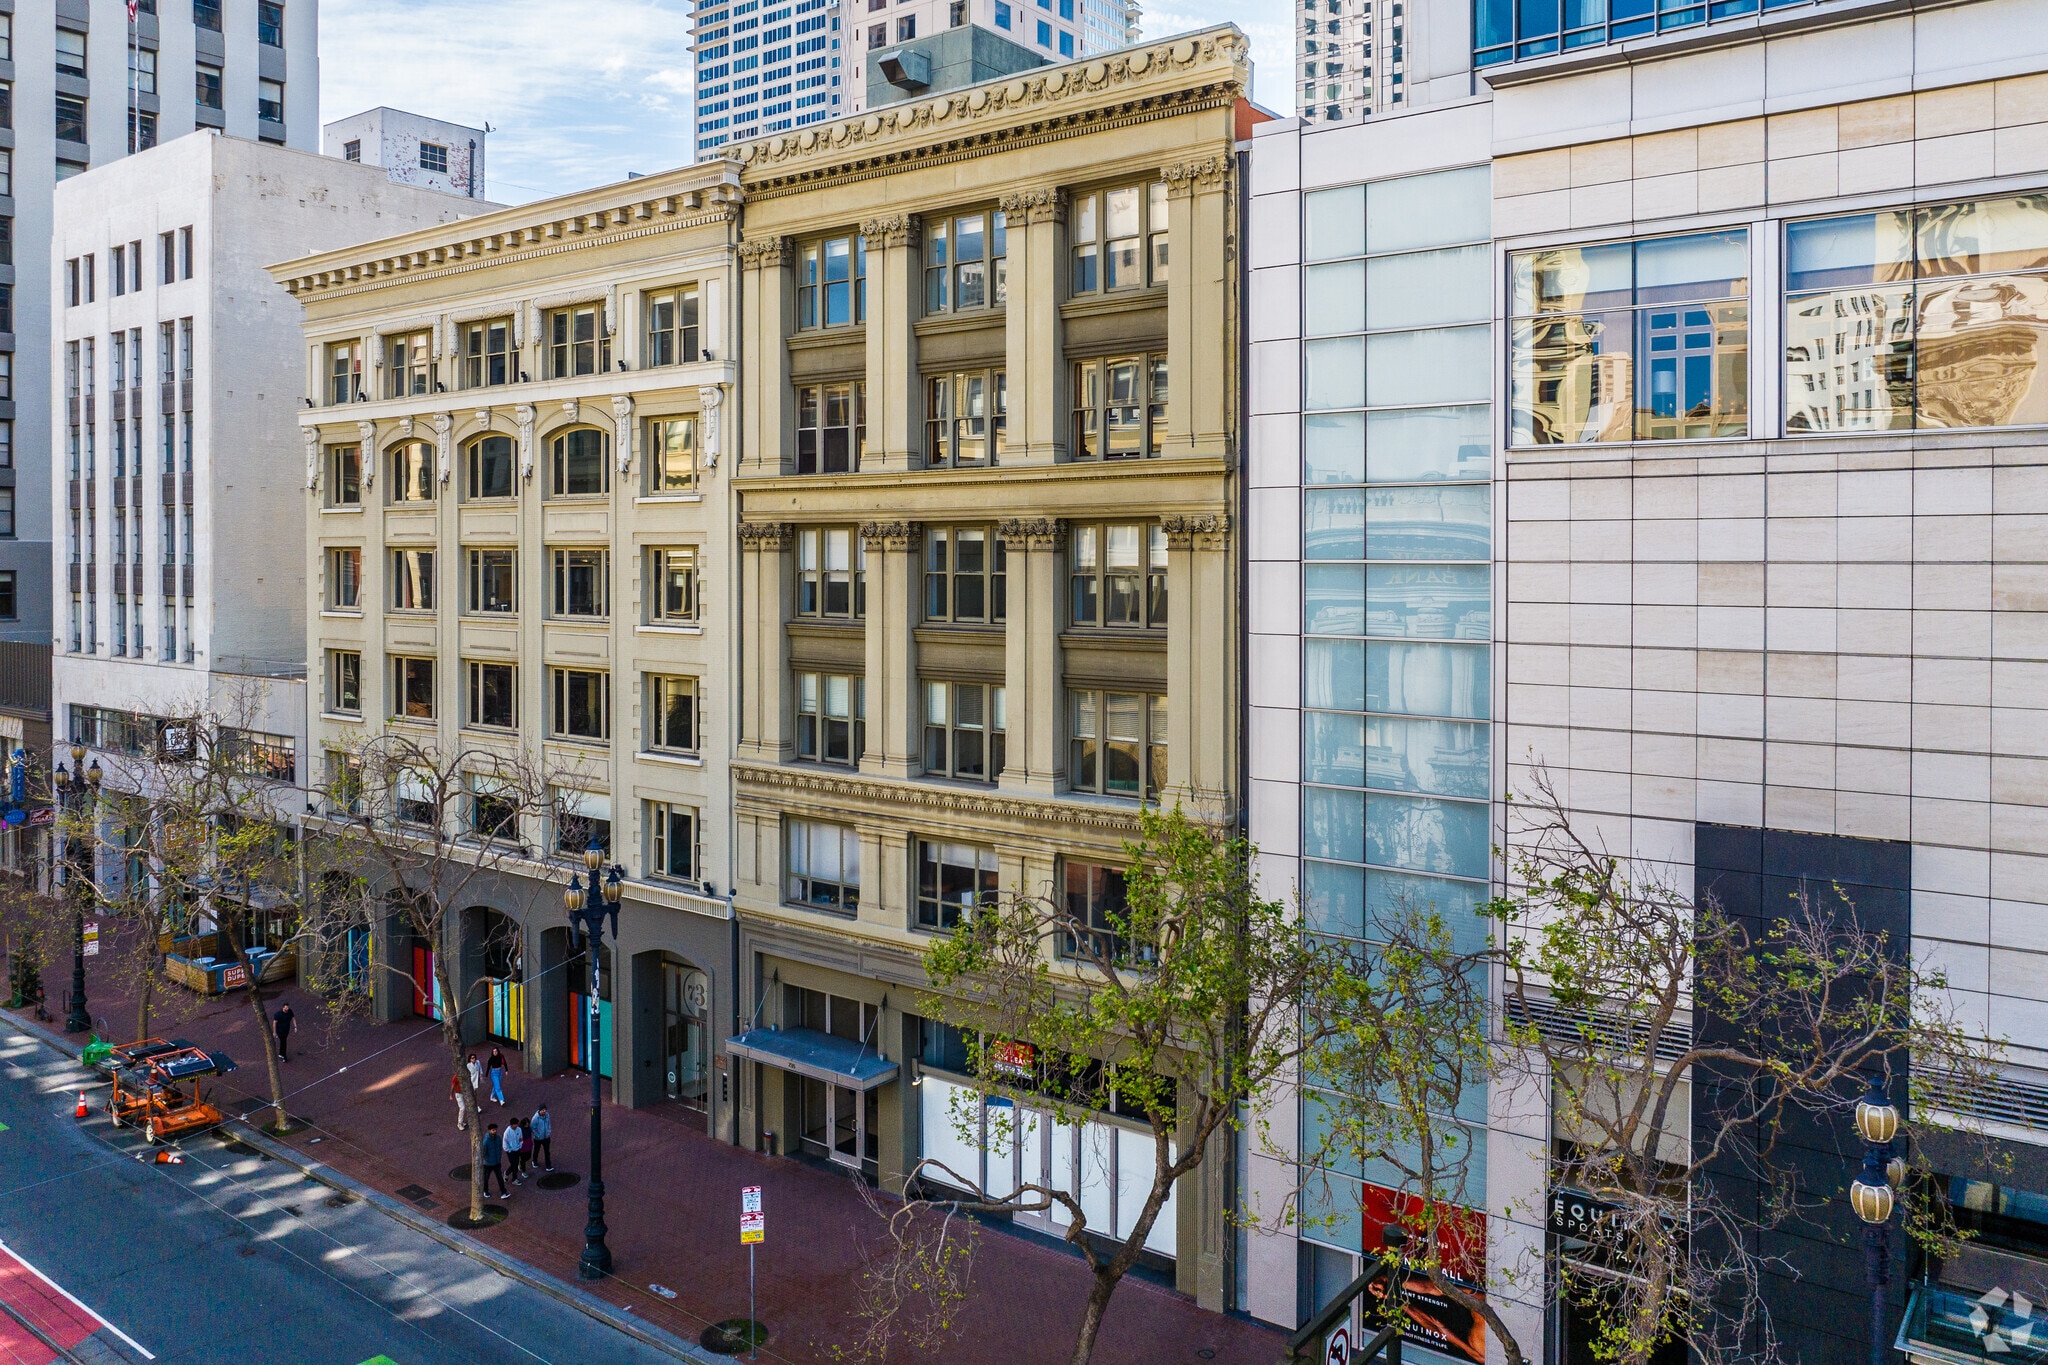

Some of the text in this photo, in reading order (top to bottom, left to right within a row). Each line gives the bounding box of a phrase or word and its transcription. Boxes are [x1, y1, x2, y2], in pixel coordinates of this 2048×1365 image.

[227, 972, 246, 981] DUPE
[1417, 1295, 1448, 1309] STRENGTH
[1404, 1322, 1448, 1341] QUINOX
